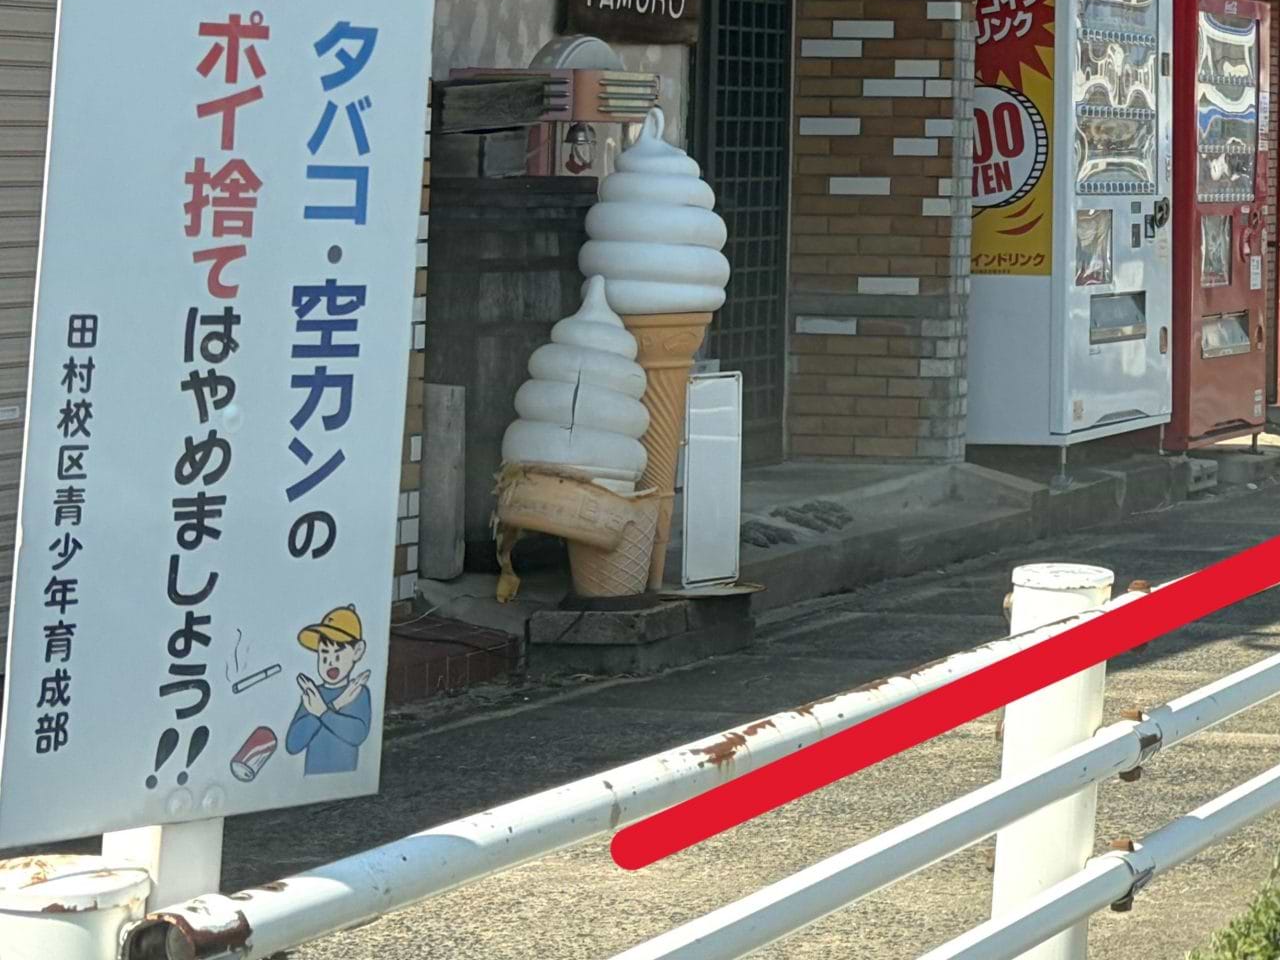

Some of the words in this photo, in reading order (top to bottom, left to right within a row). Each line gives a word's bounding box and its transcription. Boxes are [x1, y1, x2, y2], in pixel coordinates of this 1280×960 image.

[35, 313, 99, 754] 田村校区青少年育成部
[285, 20, 379, 559] タバコ・空カンの
